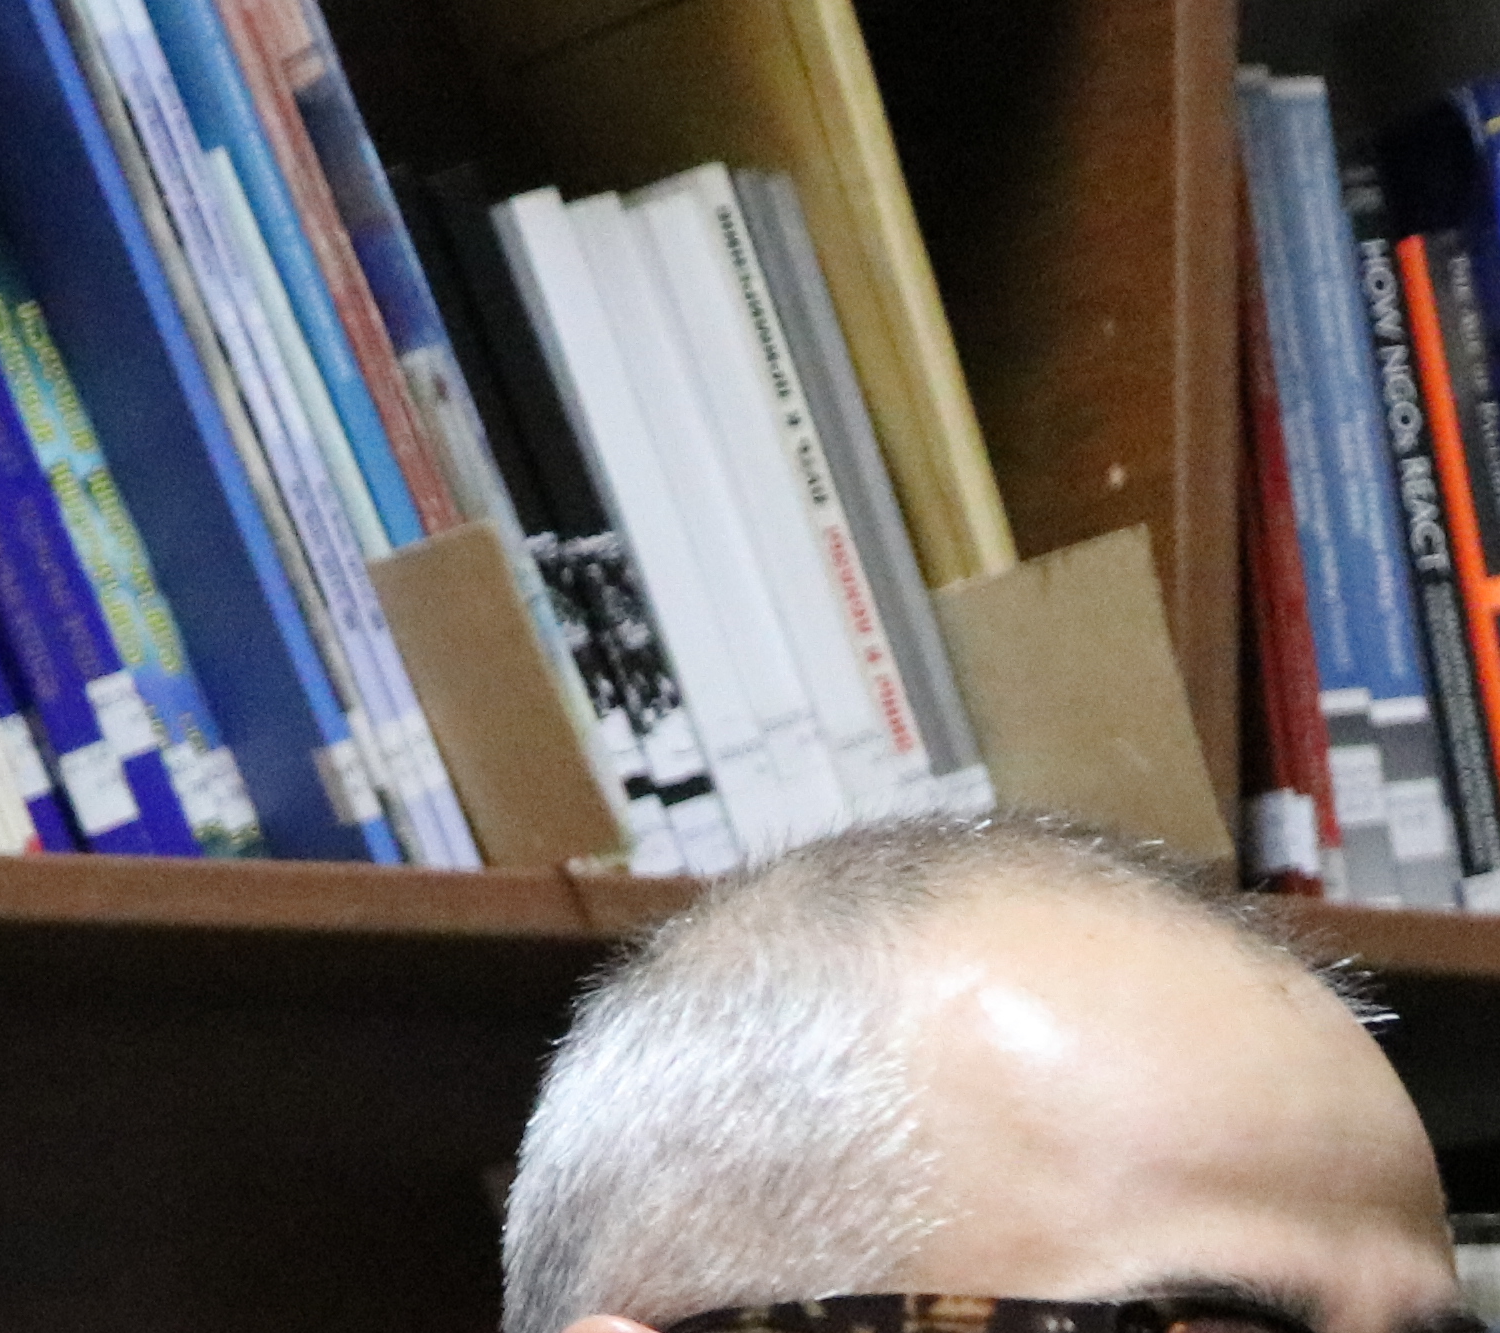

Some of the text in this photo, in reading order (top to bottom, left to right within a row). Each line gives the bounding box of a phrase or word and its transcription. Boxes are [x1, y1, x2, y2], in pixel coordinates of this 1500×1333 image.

[1356, 235, 1451, 574] HOW NGOs REACT
